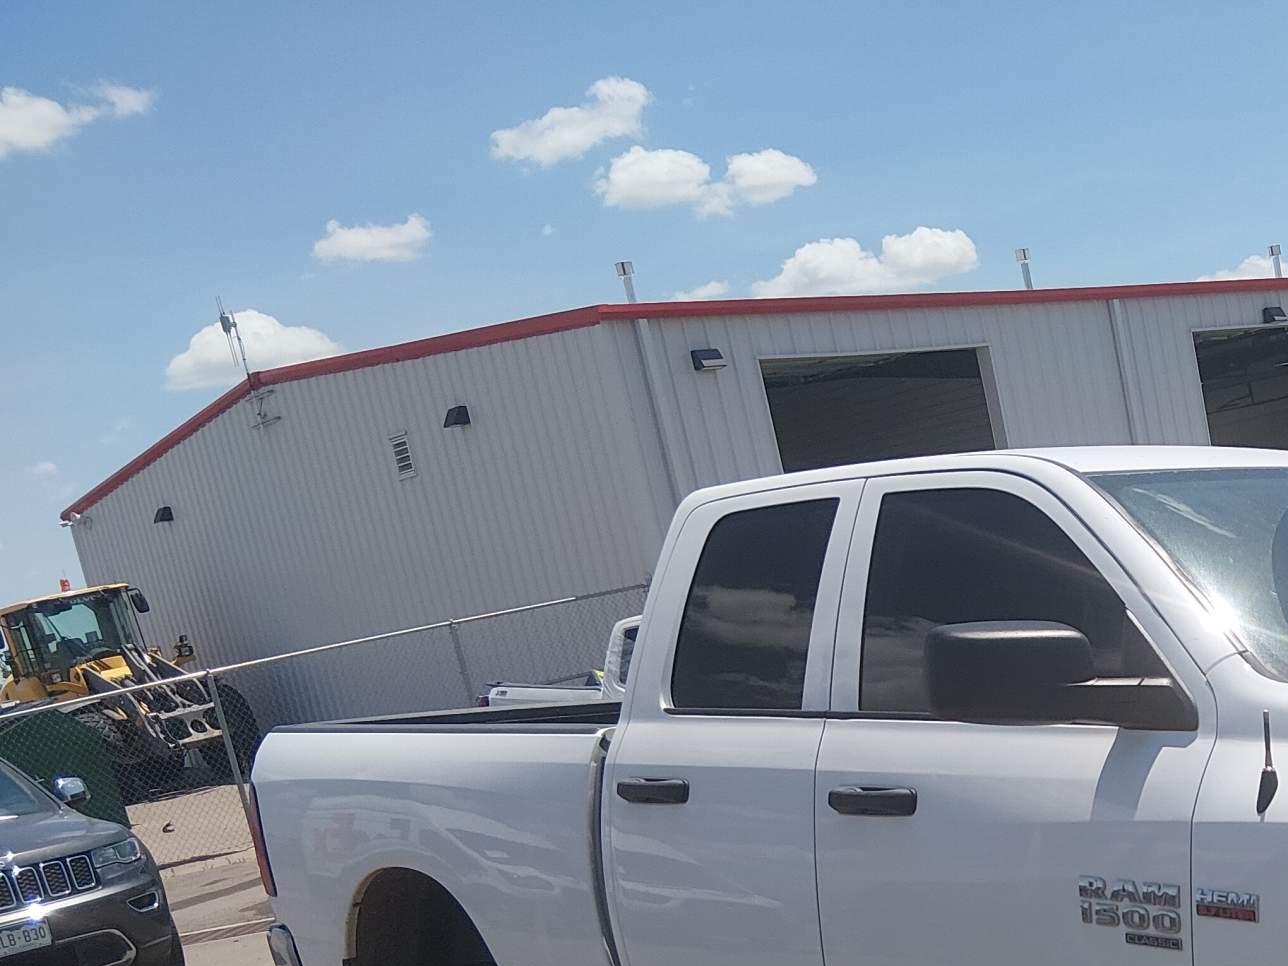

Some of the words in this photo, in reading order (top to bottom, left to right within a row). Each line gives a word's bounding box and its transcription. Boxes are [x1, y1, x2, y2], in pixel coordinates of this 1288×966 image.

[1078, 875, 1181, 909] RAM
[1196, 888, 1260, 907] HEMI
[1080, 901, 1182, 935] 1500
[1126, 933, 1182, 949] CLASSIC
